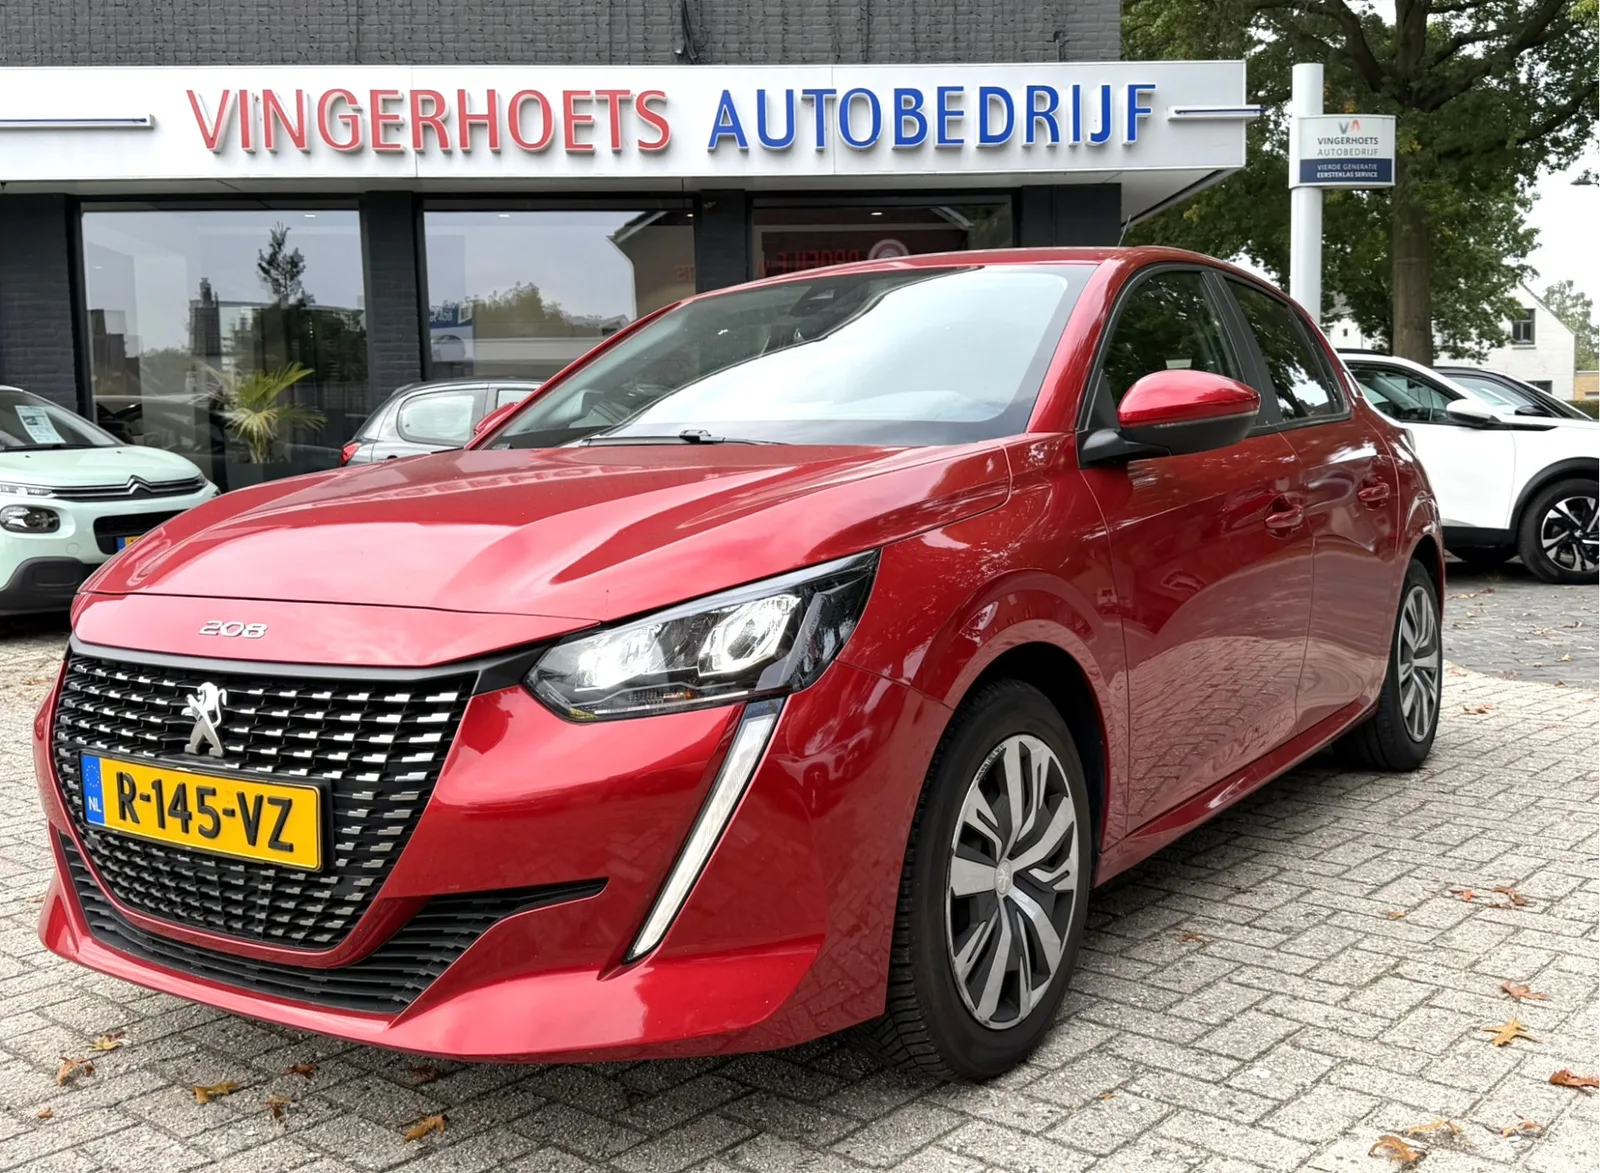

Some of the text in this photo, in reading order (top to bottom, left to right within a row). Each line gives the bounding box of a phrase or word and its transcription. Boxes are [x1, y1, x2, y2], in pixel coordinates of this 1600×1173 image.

[186, 83, 1156, 152] VINGERHOETS AUTOBEDRIJF
[1317, 136, 1379, 146] VINGERHOETS
[1317, 148, 1379, 157] AUTOBEDRIJF
[1316, 163, 1378, 171] VIERDE GENERATIE
[1316, 171, 1354, 179] EERSTEKLAS
[199, 620, 269, 639] 208
[88, 796, 102, 814] NL
[115, 771, 294, 853] R-145-VZ
